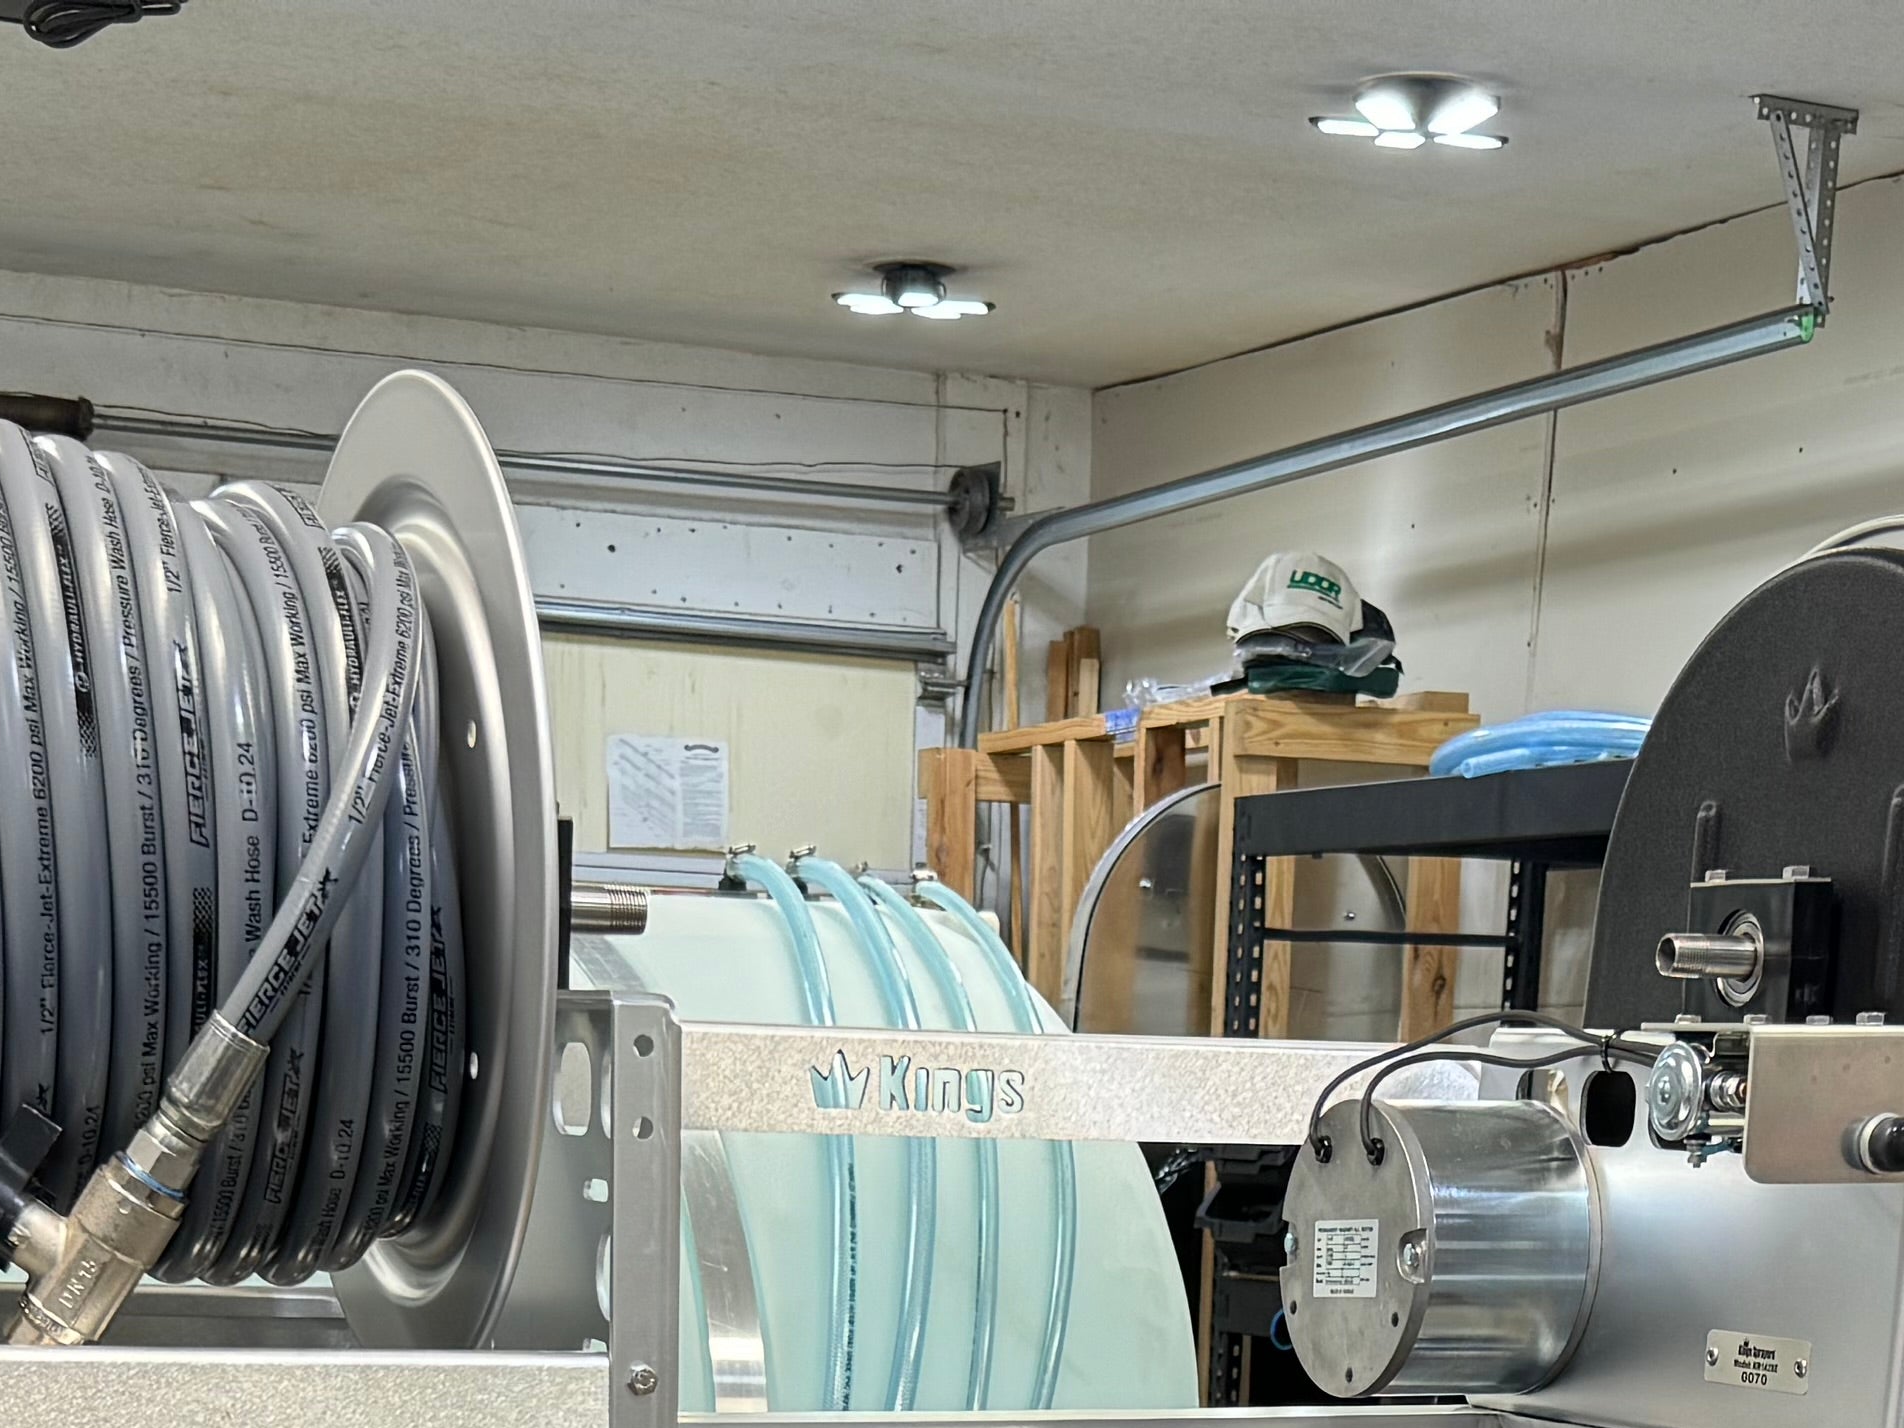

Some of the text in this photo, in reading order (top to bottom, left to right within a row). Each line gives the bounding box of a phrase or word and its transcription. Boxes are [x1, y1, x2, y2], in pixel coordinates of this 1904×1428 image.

[106, 531, 127, 570] Wash
[114, 574, 138, 648] Pressure
[1289, 569, 1342, 603] UDOR
[9, 599, 33, 669] Working
[281, 591, 306, 647] Working
[19, 674, 37, 713] Max
[291, 651, 311, 685] Max
[125, 664, 149, 741] Degrees
[294, 689, 316, 716] psi
[24, 718, 47, 748] psi
[28, 751, 47, 800] 6200
[137, 803, 158, 854] Burst
[33, 806, 57, 990] Fierce-Jet-Extreme
[141, 861, 159, 921] 15500
[243, 835, 262, 943] Wash Hose
[142, 941, 163, 1015] Working
[375, 835, 424, 1187] Max Working 15500 Burst 310 Degrees
[142, 1020, 160, 1057] Max
[879, 1055, 1025, 1123] Kings
[1741, 1371, 1767, 1386] 0070
